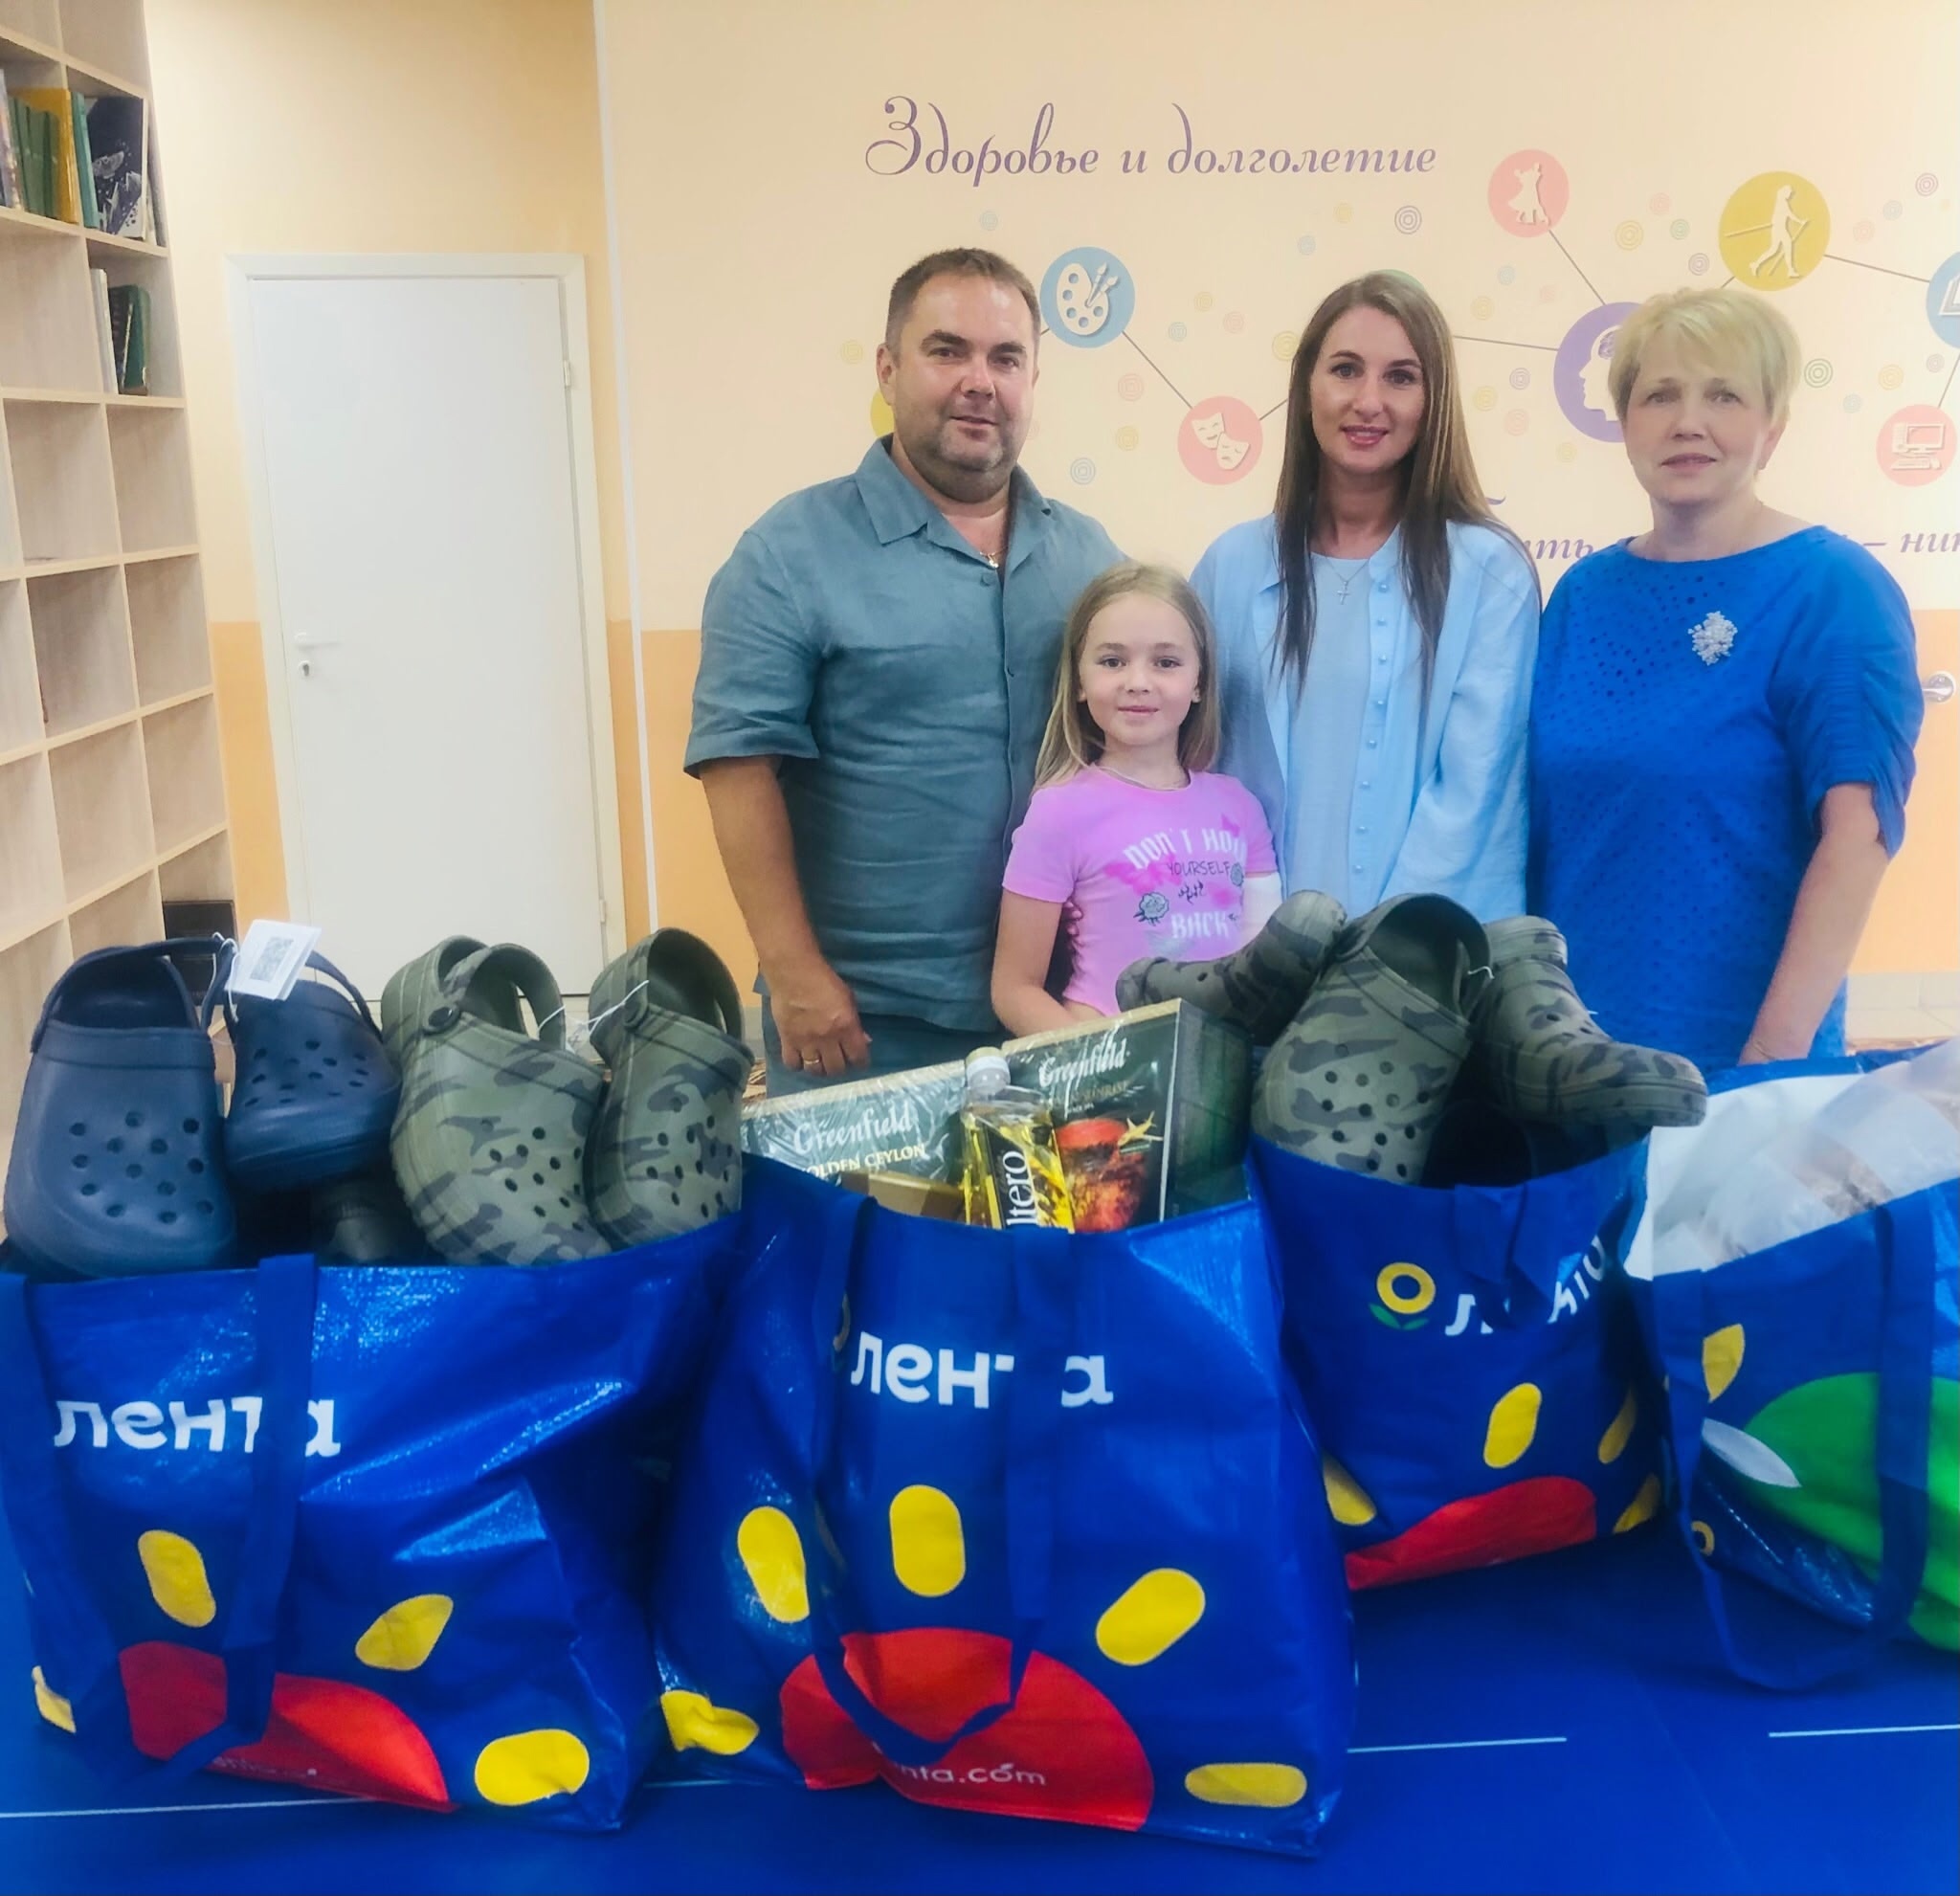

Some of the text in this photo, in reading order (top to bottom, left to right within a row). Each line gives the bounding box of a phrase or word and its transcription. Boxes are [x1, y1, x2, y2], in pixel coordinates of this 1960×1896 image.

[865, 95, 1437, 187] Здоровье и долголетие
[1524, 539, 1593, 560] ть
[1167, 860, 1231, 877] YOURSELF
[1038, 1032, 1129, 1088] Greenfield
[793, 1100, 913, 1155] Greenfield
[864, 1144, 926, 1168] CEYLON
